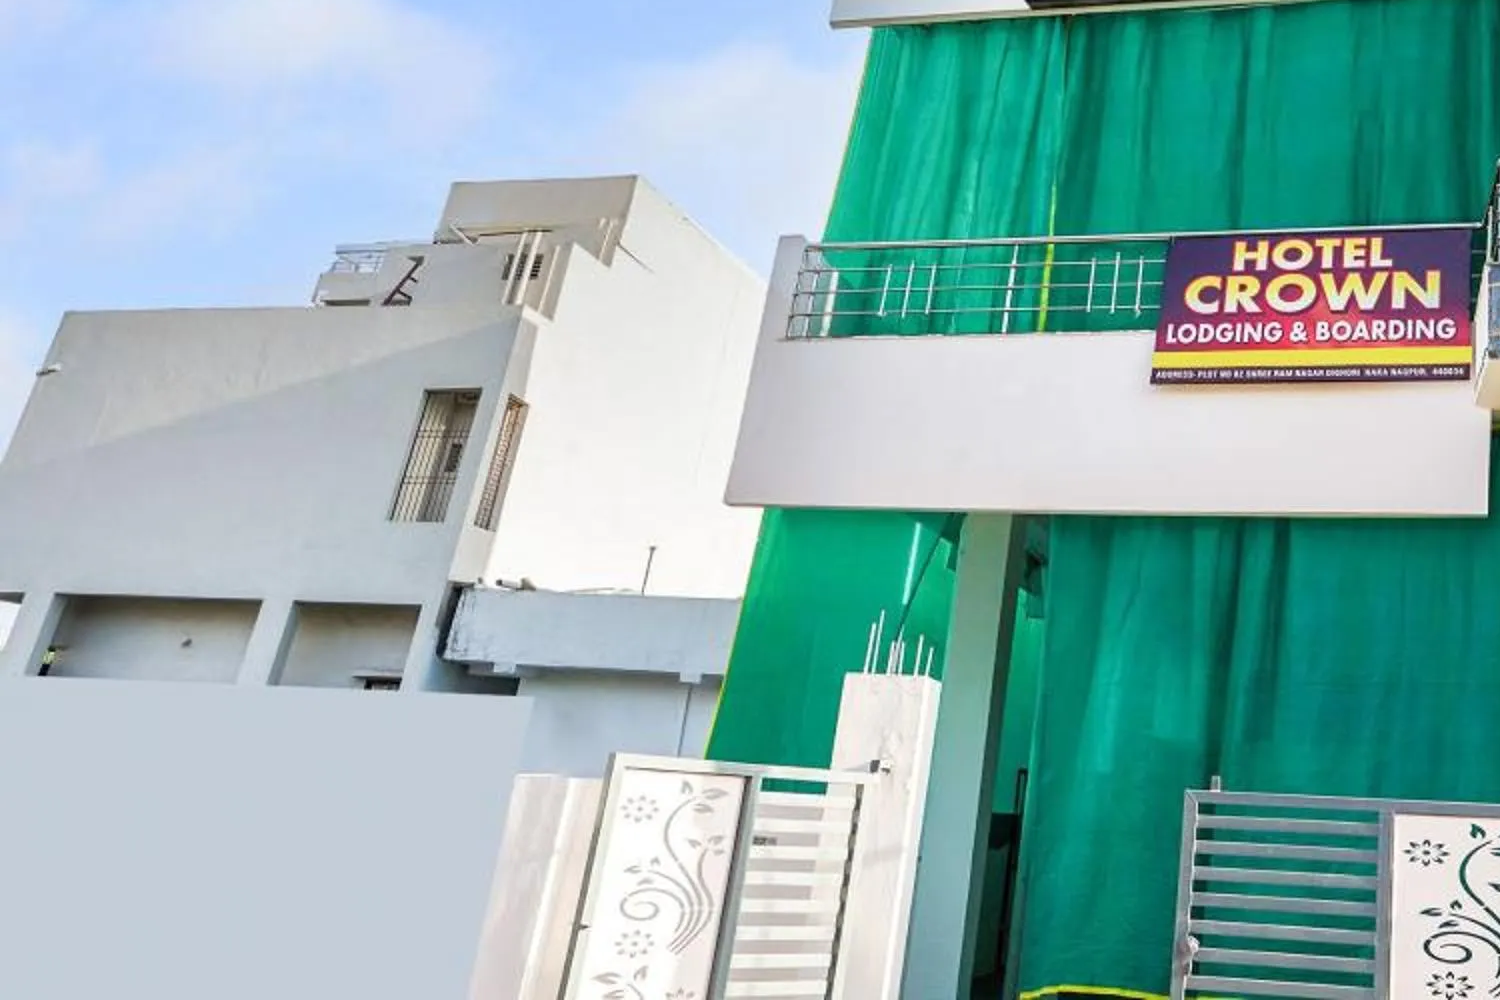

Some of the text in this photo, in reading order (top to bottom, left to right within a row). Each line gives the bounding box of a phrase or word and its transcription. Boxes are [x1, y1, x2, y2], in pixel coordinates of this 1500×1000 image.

[1232, 237, 1393, 271] HOTEL
[1184, 270, 1442, 315] CROWN
[1165, 318, 1457, 344] LODGING & BOARDING
